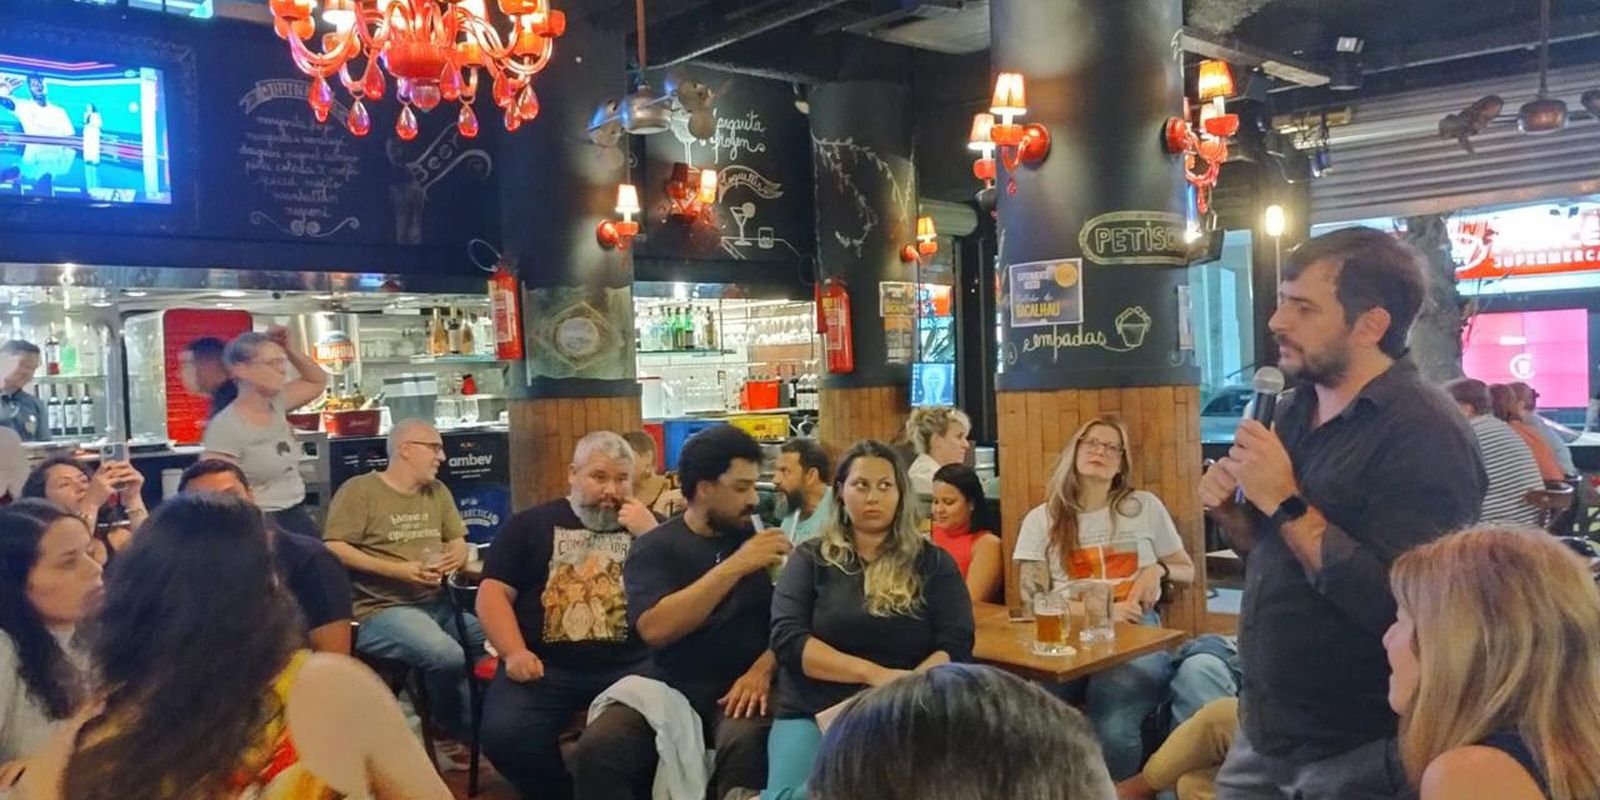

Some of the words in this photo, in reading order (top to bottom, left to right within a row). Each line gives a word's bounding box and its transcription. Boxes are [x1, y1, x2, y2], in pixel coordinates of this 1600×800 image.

[1015, 302, 1060, 318] BACALHAU
[1033, 324, 1107, 361] empadas
[449, 454, 493, 468] ambev
